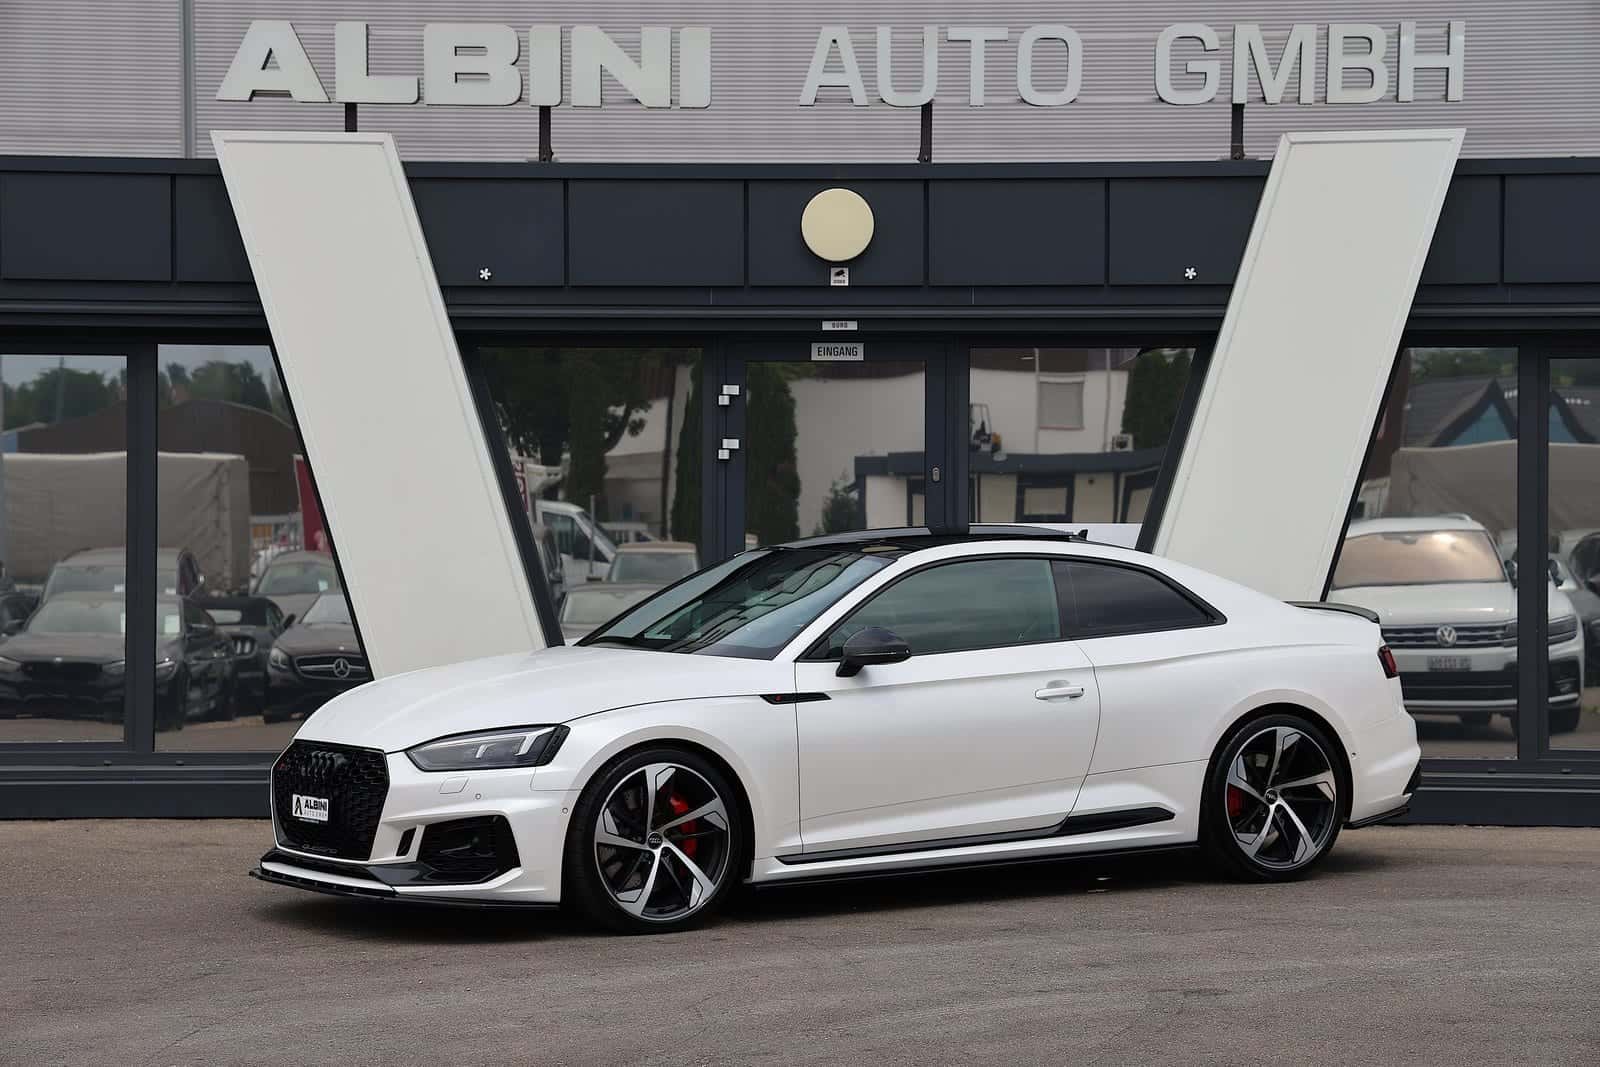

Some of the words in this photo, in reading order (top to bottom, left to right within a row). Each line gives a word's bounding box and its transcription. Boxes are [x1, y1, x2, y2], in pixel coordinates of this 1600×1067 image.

[216, 20, 712, 108] ALBINI
[800, 24, 1084, 107] AUTO
[1154, 21, 1466, 106] GMBH
[817, 346, 858, 357] EINGANG
